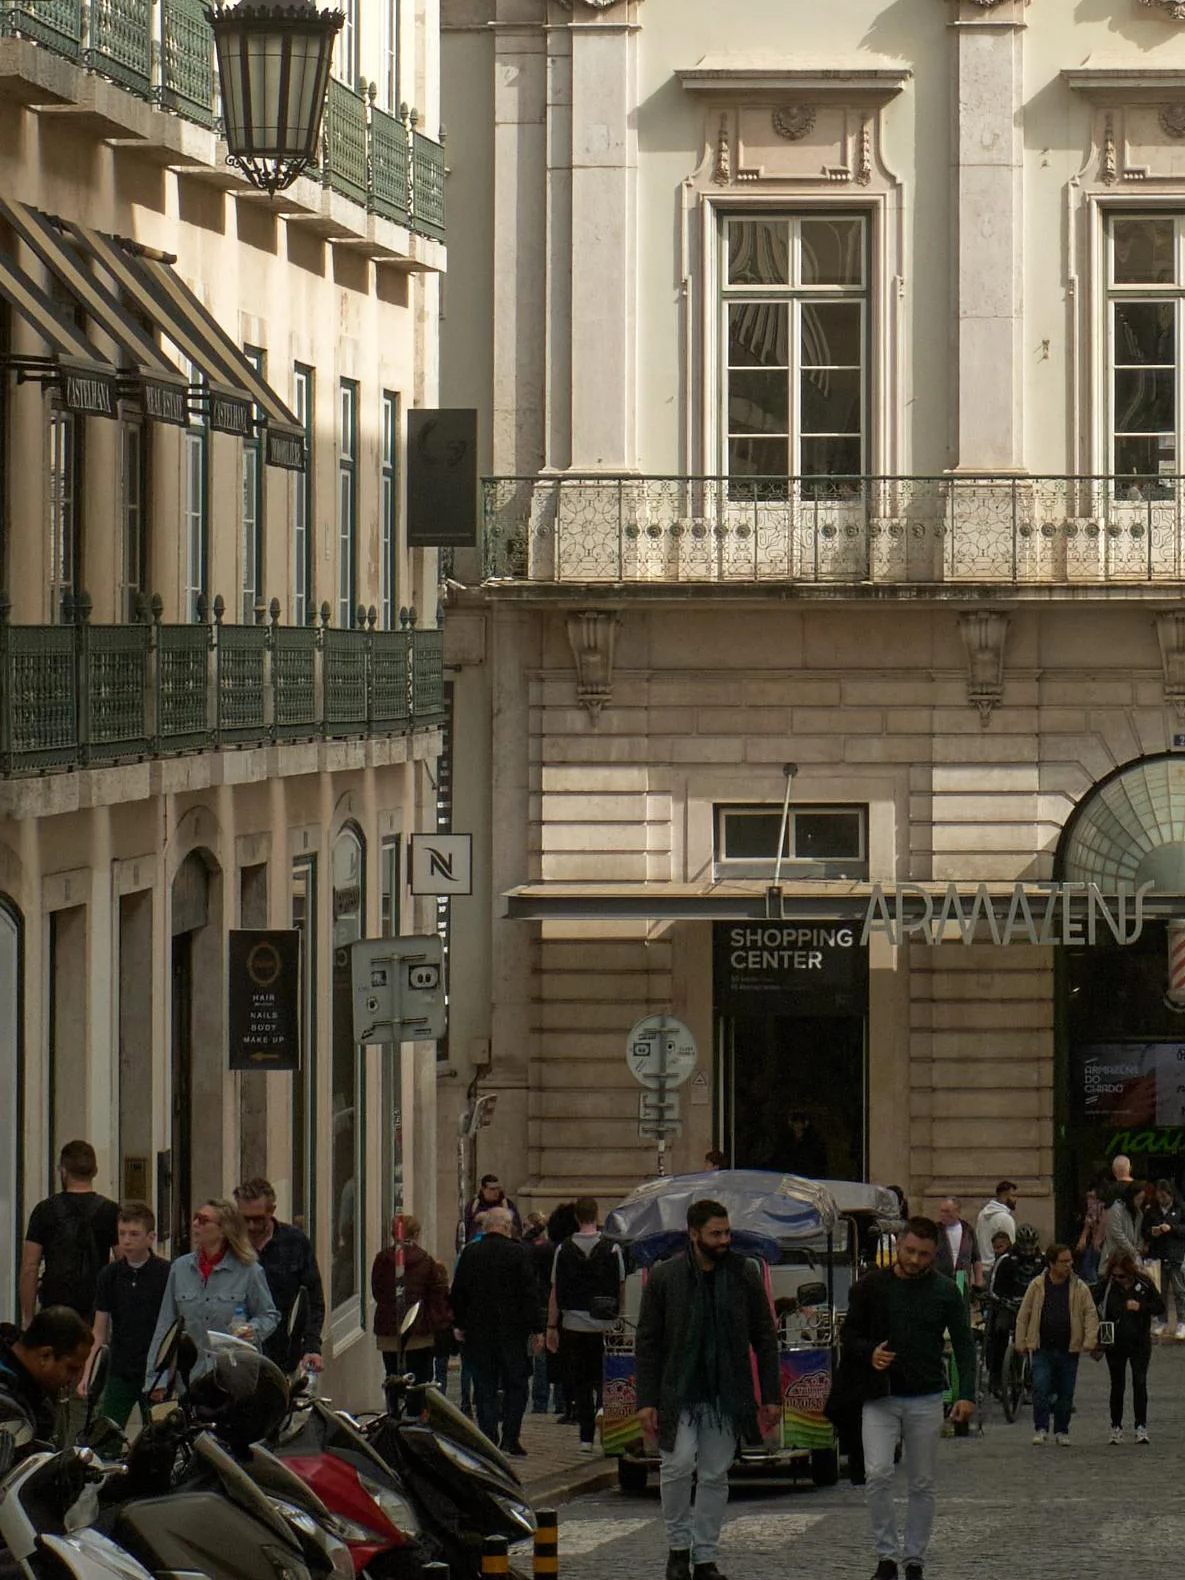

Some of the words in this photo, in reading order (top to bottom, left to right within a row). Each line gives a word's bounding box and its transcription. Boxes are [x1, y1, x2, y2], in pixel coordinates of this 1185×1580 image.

[422, 847, 461, 882] N
[860, 879, 1155, 947] ARMAZENS
[730, 928, 854, 948] SHOPPING
[730, 951, 823, 969] CENTER
[252, 994, 276, 1002] HAIR
[250, 1011, 278, 1019] NAILS
[250, 1024, 277, 1032] BODY
[243, 1036, 269, 1044] MAKE
[273, 1036, 285, 1044] UP
[1084, 1075, 1101, 1084] DO
[1084, 1084, 1124, 1093] CHIADO
